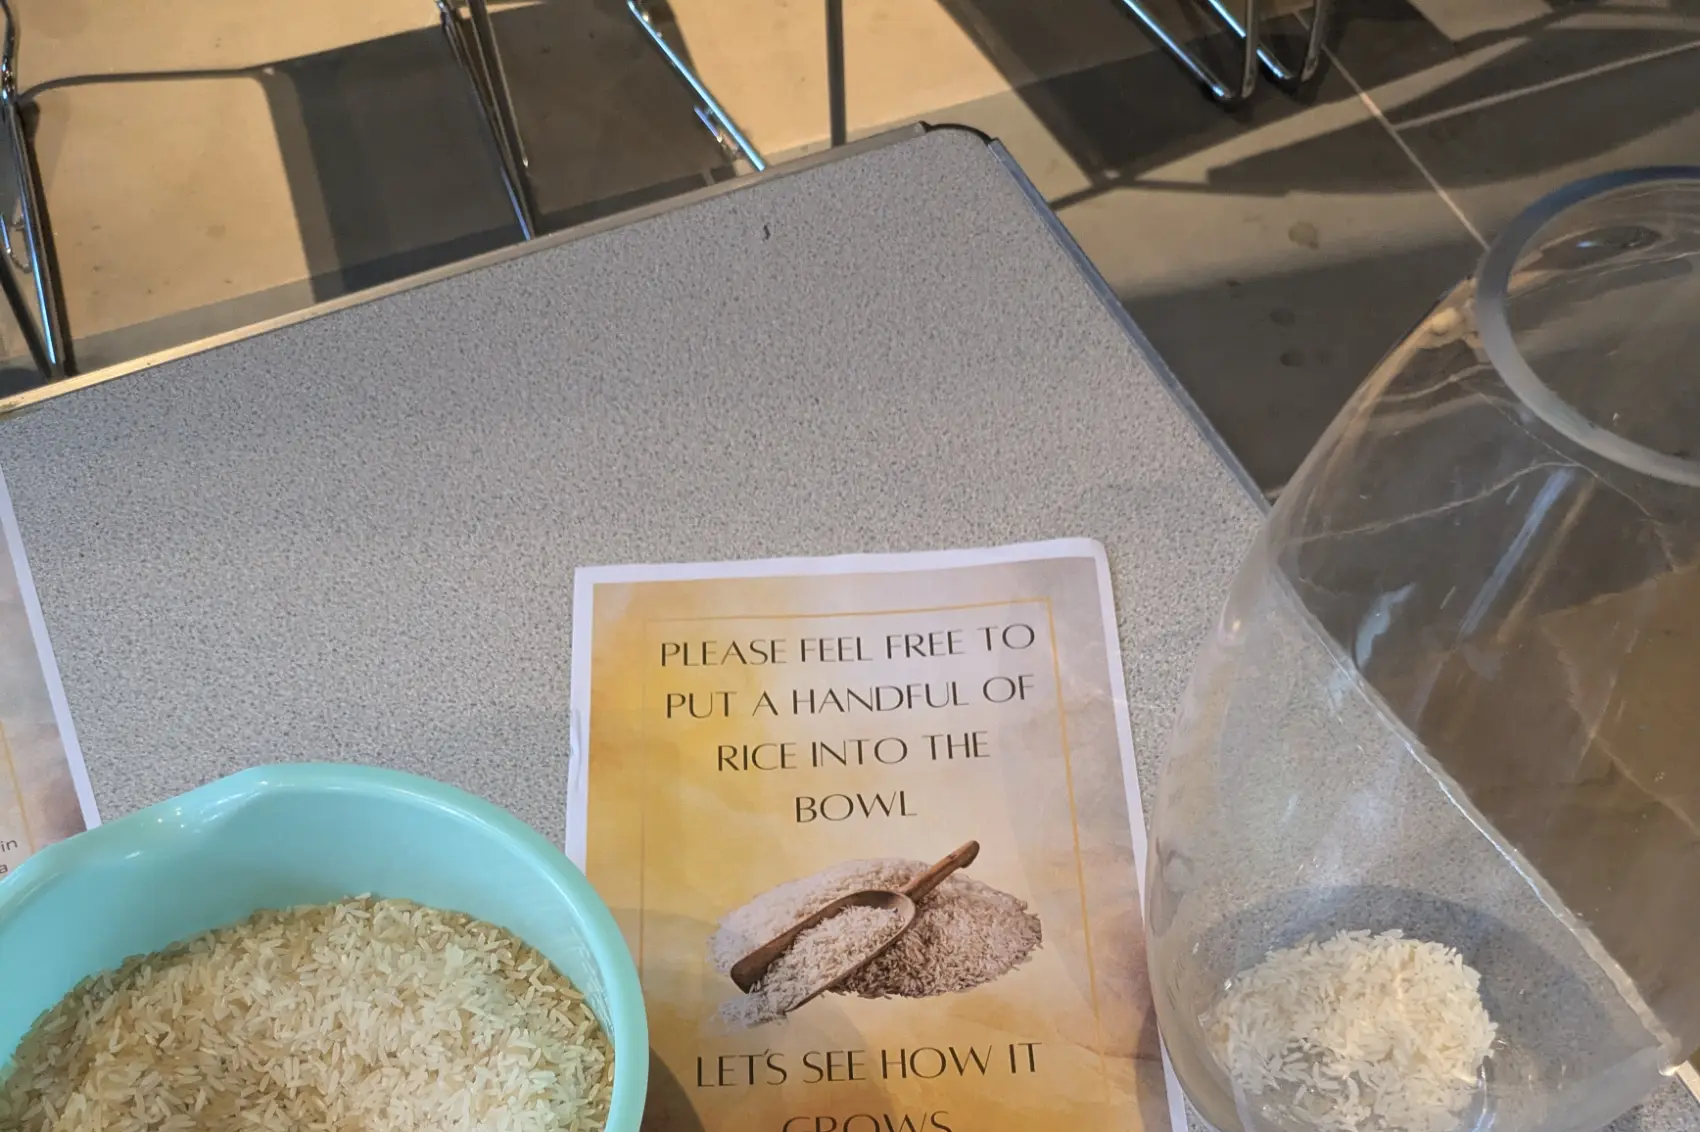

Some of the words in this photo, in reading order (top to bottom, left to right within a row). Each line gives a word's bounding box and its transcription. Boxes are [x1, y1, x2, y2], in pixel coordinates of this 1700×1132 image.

[661, 638, 787, 667] PLEASE
[800, 636, 873, 662] FEEL
[886, 629, 966, 659] FREE
[976, 623, 1035, 651] TO
[666, 690, 737, 719] PUT
[752, 690, 779, 716] A
[792, 681, 970, 715] HANDFUL
[983, 673, 1035, 703] OF
[717, 742, 798, 772] RICE
[811, 737, 908, 768] INTO
[921, 730, 991, 760] THE
[795, 790, 918, 824] BOWL
[697, 1048, 787, 1087] LET'S
[802, 1049, 867, 1084] SEE
[881, 1044, 993, 1079] HOW
[1008, 1042, 1043, 1074] IT
